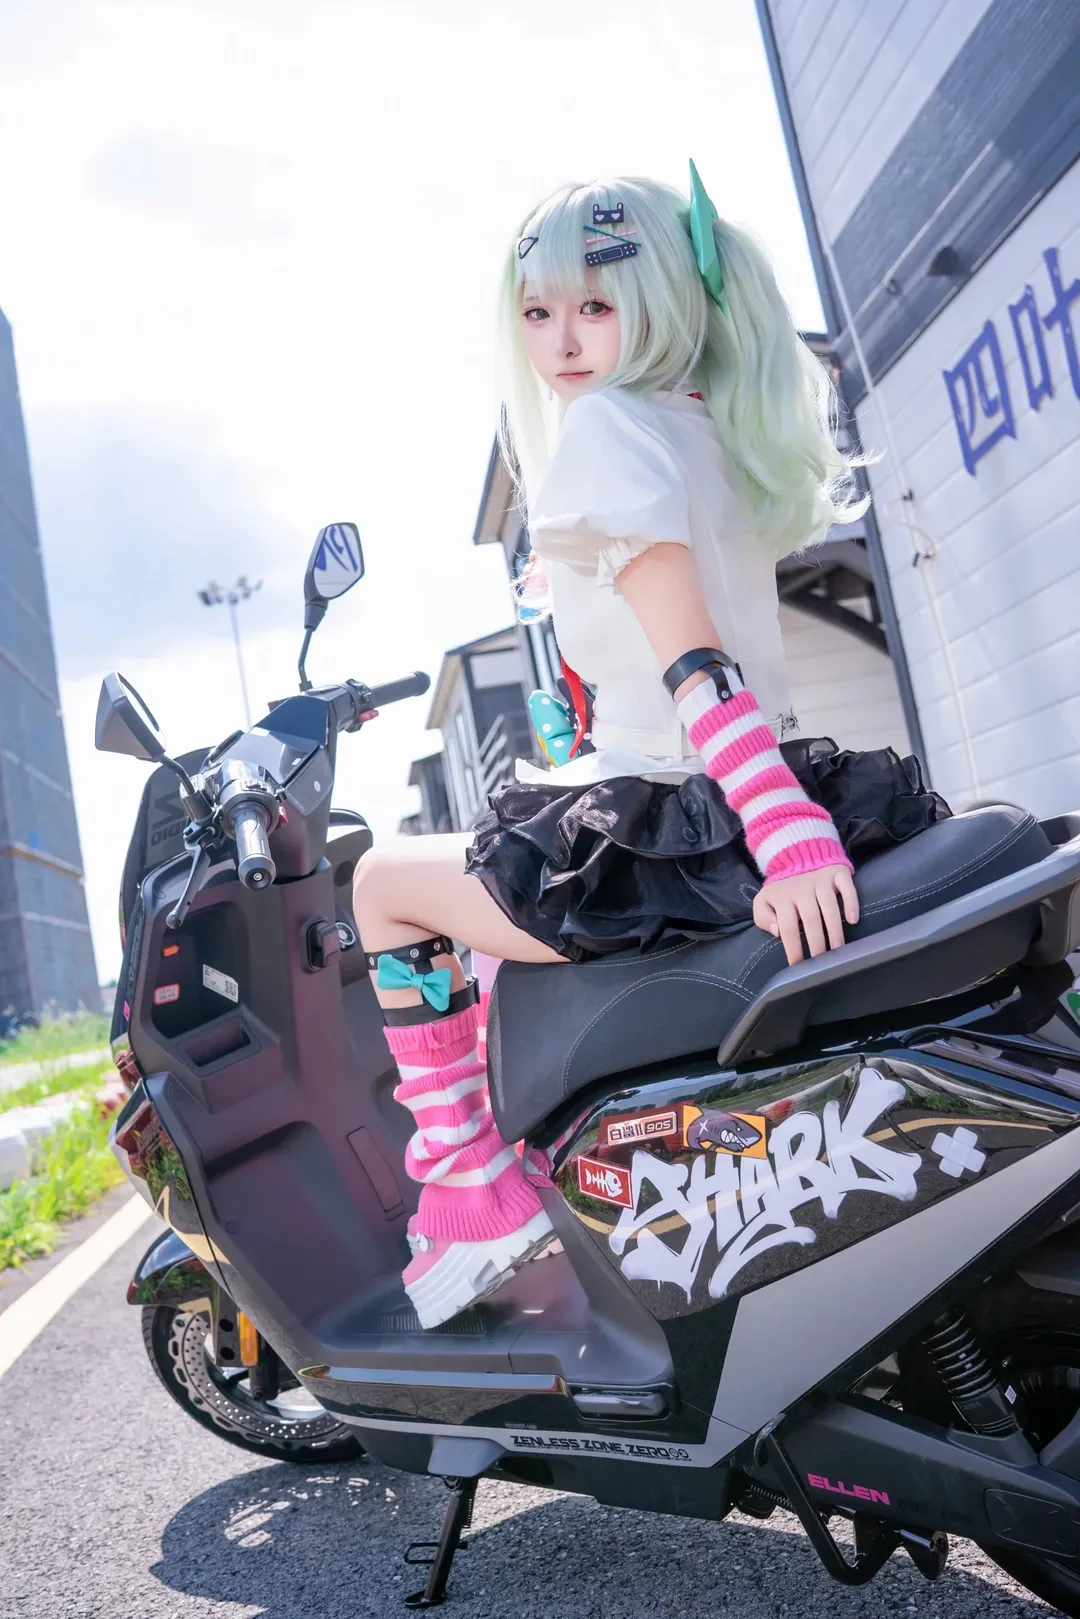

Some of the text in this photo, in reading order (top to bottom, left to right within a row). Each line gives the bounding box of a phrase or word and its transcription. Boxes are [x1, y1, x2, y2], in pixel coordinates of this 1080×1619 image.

[608, 1067, 922, 1304] SHARK
[510, 1434, 580, 1448] ZENLESS
[580, 1438, 624, 1452] ZONE
[625, 1443, 670, 1457] ZERO
[806, 1472, 891, 1506] ELLEN
